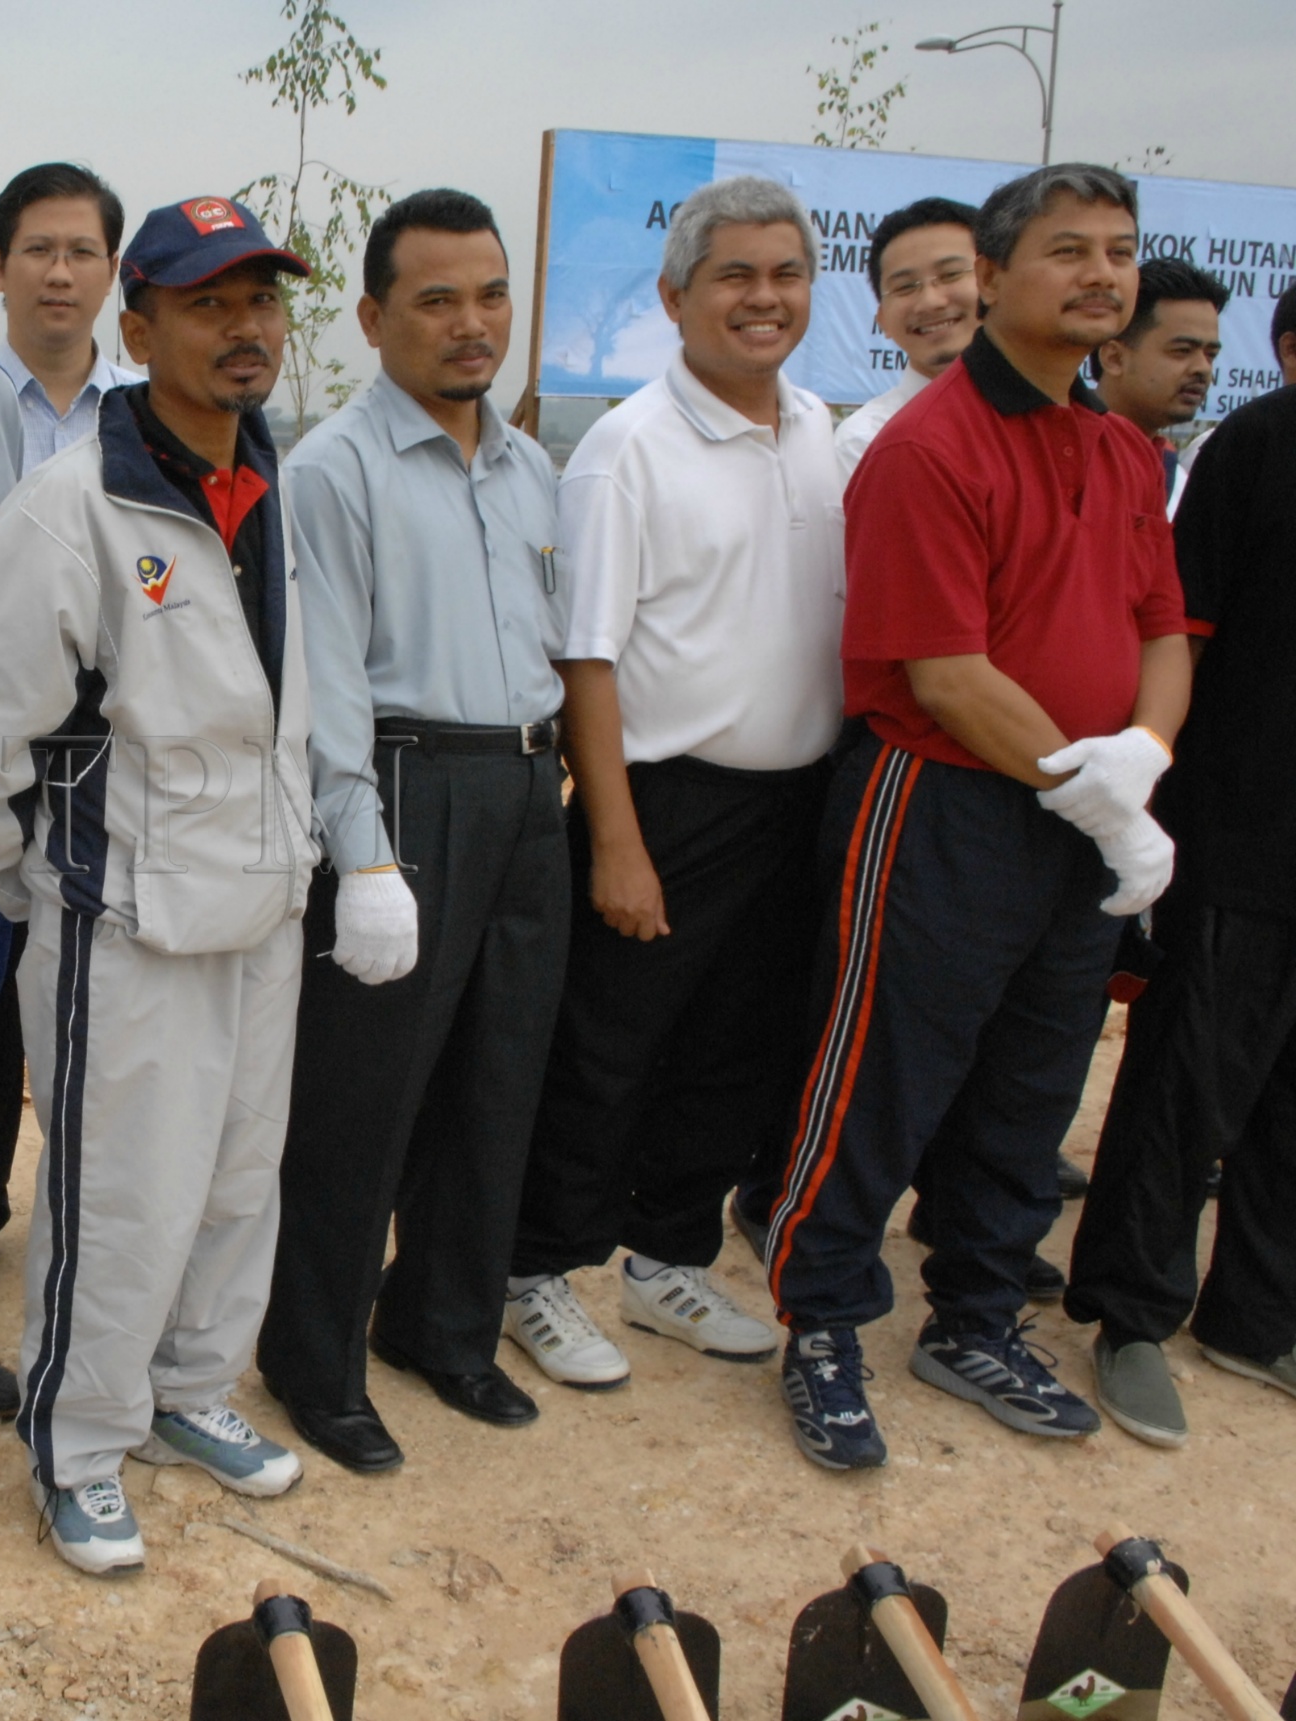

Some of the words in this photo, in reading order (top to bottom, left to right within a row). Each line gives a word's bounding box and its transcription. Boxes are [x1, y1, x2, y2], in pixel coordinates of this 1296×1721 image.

[820, 243, 871, 273] EMP
[1141, 233, 1197, 262] KOK
[1208, 238, 1296, 270] HUTAN
[869, 348, 910, 370] TEM
[1228, 367, 1281, 390] SHAH
